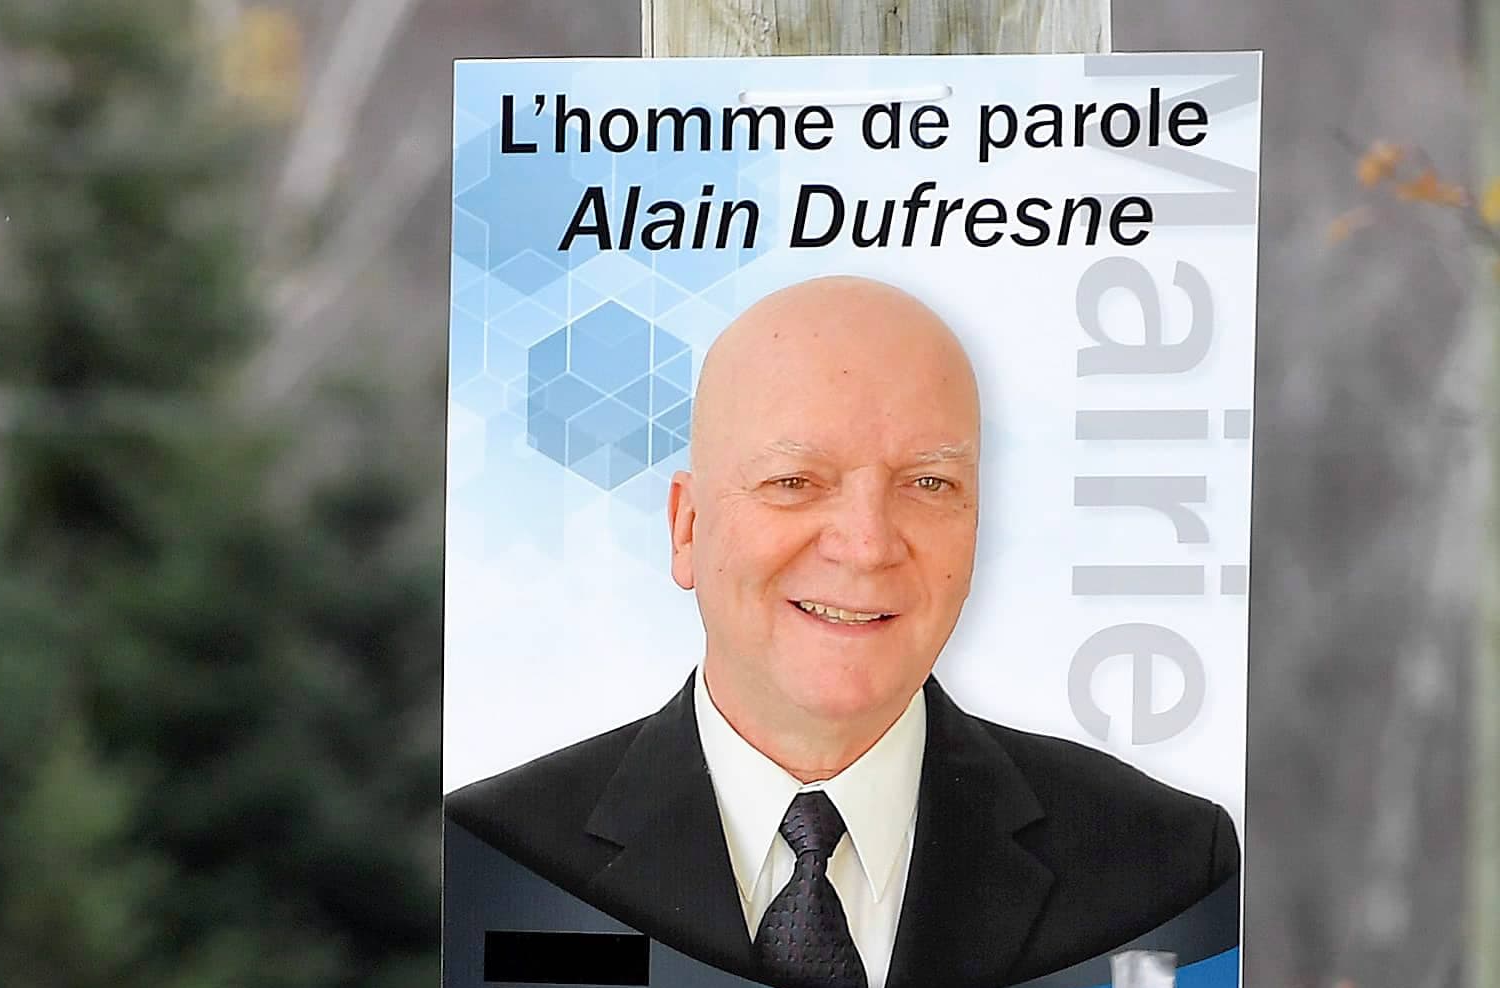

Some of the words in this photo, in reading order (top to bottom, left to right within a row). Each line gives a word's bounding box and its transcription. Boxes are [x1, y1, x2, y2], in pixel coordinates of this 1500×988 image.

[861, 102, 949, 150] de
[979, 87, 1209, 163] parole
[557, 184, 760, 251] Alain
[789, 181, 1154, 248] Dufresne
[1067, 54, 1258, 746] Mairie
